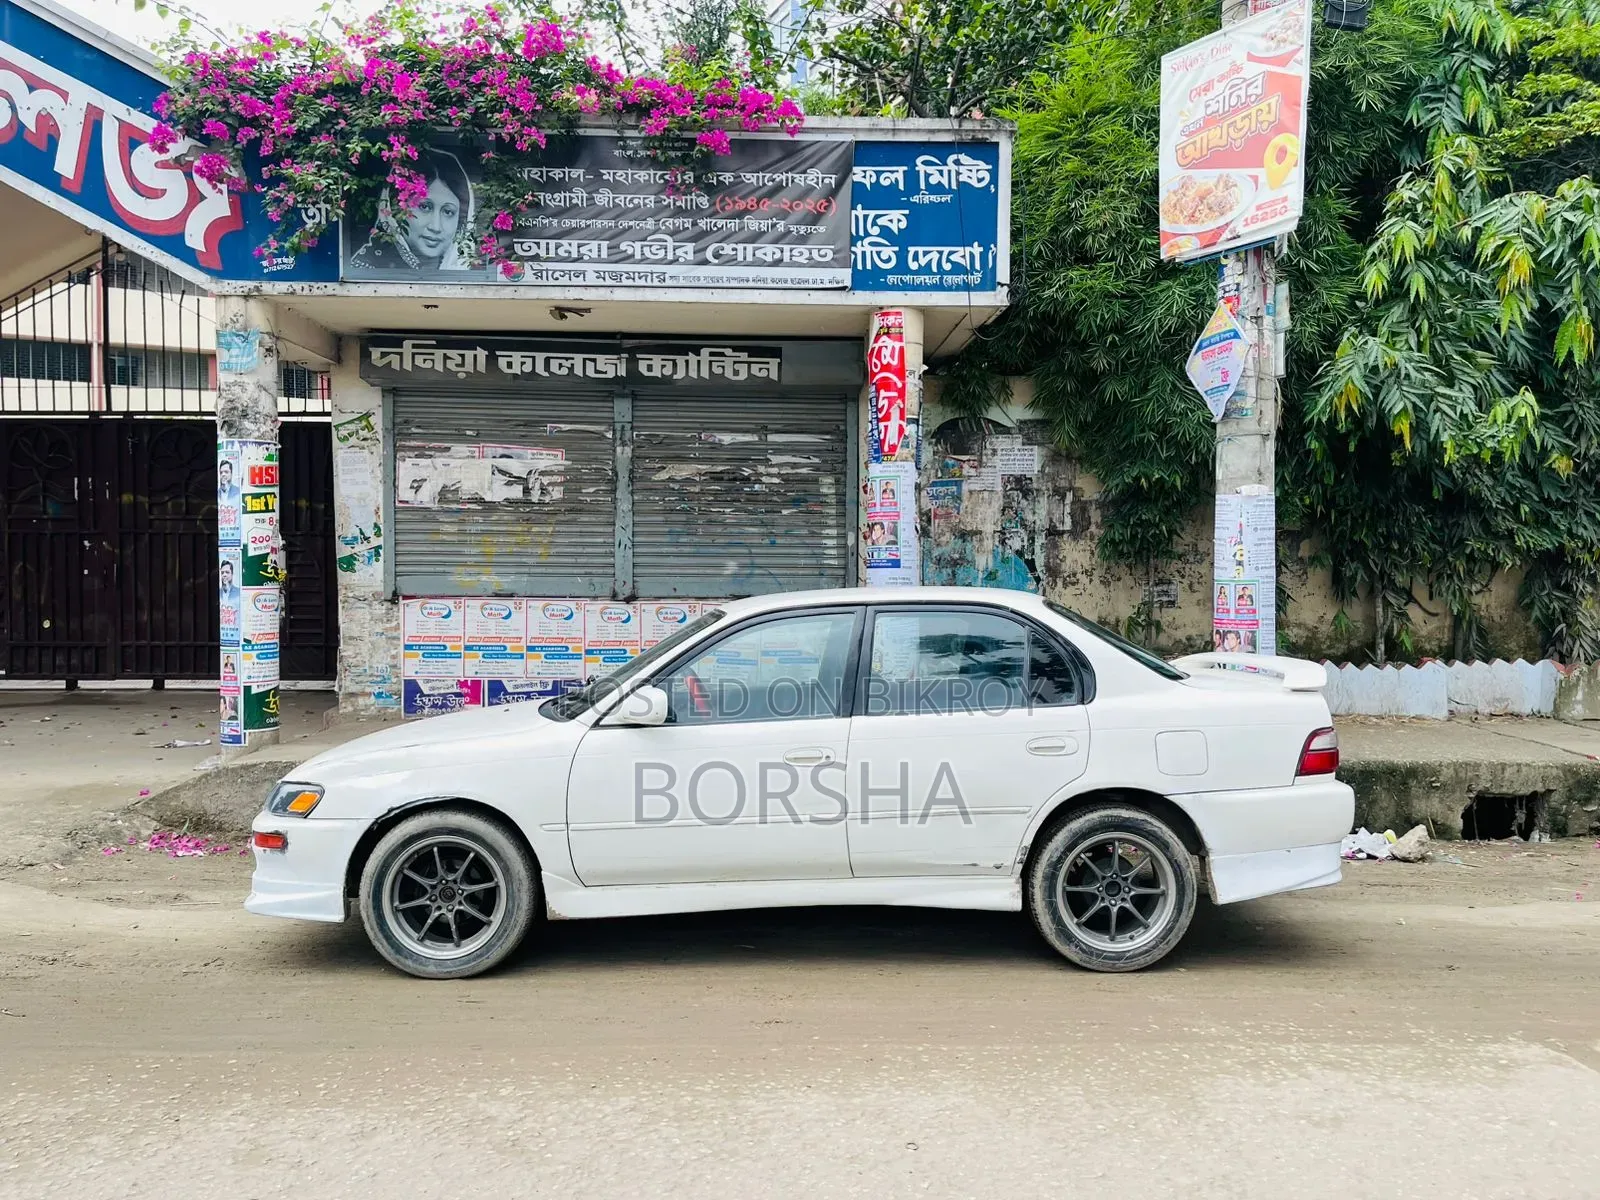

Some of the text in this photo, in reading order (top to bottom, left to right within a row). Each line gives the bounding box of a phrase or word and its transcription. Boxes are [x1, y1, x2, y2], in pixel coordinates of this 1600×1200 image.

[1204, 72, 1267, 117] শনির
[740, 168, 838, 190] আপোষহীন
[593, 188, 656, 208] জীবনের
[716, 195, 838, 217] (১৯৪৫-২০২৫)
[561, 217, 615, 229] চেয়ারপারসন
[659, 217, 692, 231] বেগম
[697, 217, 739, 232] খালেদা
[513, 234, 835, 263] আমরা গভীর শোকাহত
[368, 340, 781, 382] দনিয়া কলেজ ক্যান্টিন
